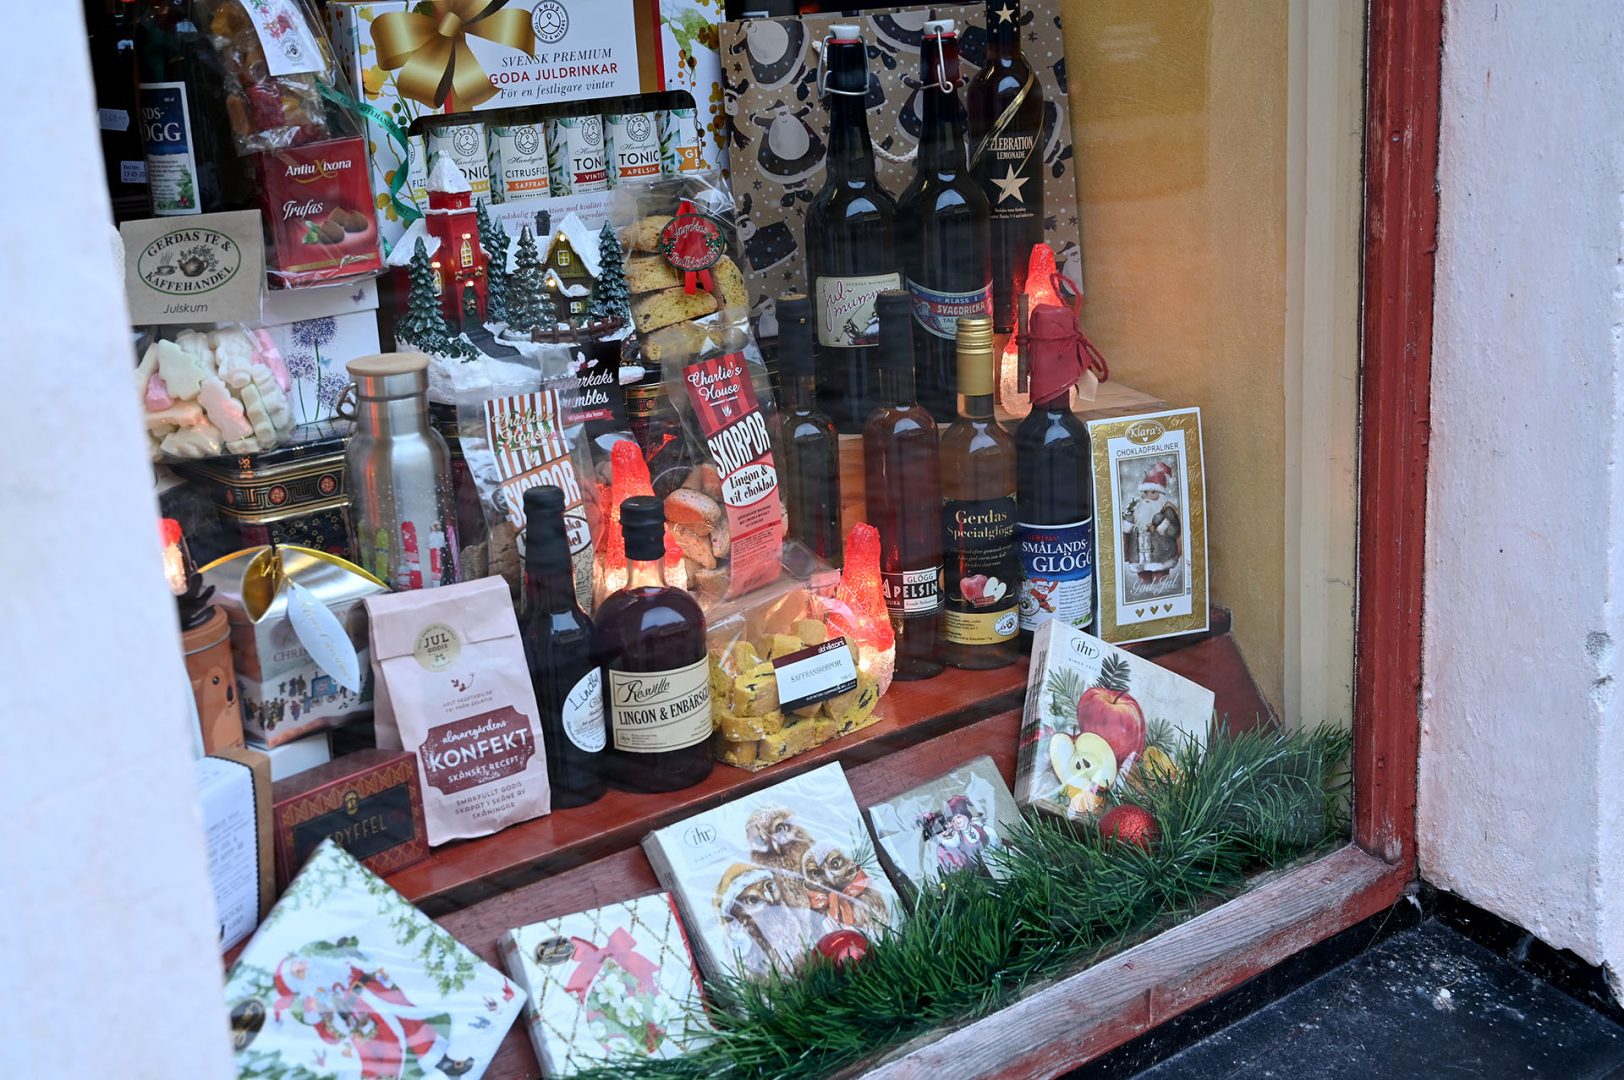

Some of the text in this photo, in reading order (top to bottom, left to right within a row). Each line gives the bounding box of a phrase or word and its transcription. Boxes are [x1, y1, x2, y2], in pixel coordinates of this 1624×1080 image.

[501, 48, 613, 68] SVENSK PREMIUM
[489, 62, 619, 85] GODA JULDRINKAR
[500, 79, 616, 99] För en festligare vinter
[619, 150, 660, 166] TONIC
[996, 151, 1026, 160] LEMONADE
[505, 166, 548, 179] CITRUSFIZZ
[515, 181, 545, 189] SAFFRAN
[282, 199, 324, 220] Trufas
[147, 230, 231, 257] GERDAS TE &
[145, 265, 234, 291] KAFFEHANDEL
[163, 303, 209, 314] Julskum
[687, 361, 743, 387] Charlie's
[698, 383, 740, 401] House
[491, 404, 555, 429] Charlie's
[499, 427, 552, 446] House
[1128, 425, 1163, 438] Klara's
[707, 411, 771, 479] SKORPOR
[1116, 442, 1179, 457] CHOKLADPRALINER
[728, 465, 769, 489] Lingon &
[729, 475, 775, 505] vit choklad
[955, 509, 1007, 525] Gerdas
[947, 524, 1014, 540] Specialglögg
[1022, 539, 1088, 554] SMÅLANDS-
[906, 573, 934, 583] GLÖGG
[1130, 579, 1156, 596] God
[1156, 573, 1178, 595] Jul
[882, 578, 938, 598] APELSIN
[424, 633, 449, 648] JUL
[1076, 640, 1093, 656] ihr
[618, 709, 657, 726] LINGON
[659, 707, 669, 720] &
[429, 727, 528, 773] KONFEKT
[448, 765, 487, 783] SKÅNSKT
[489, 755, 519, 771] RECEPT
[455, 802, 485, 815] SKAPAT
[492, 793, 515, 805] SKÅNE
[517, 788, 526, 796] AV
[456, 781, 523, 806] SMAKFULLT GODIS
[472, 802, 516, 820] SKÅNINGAR
